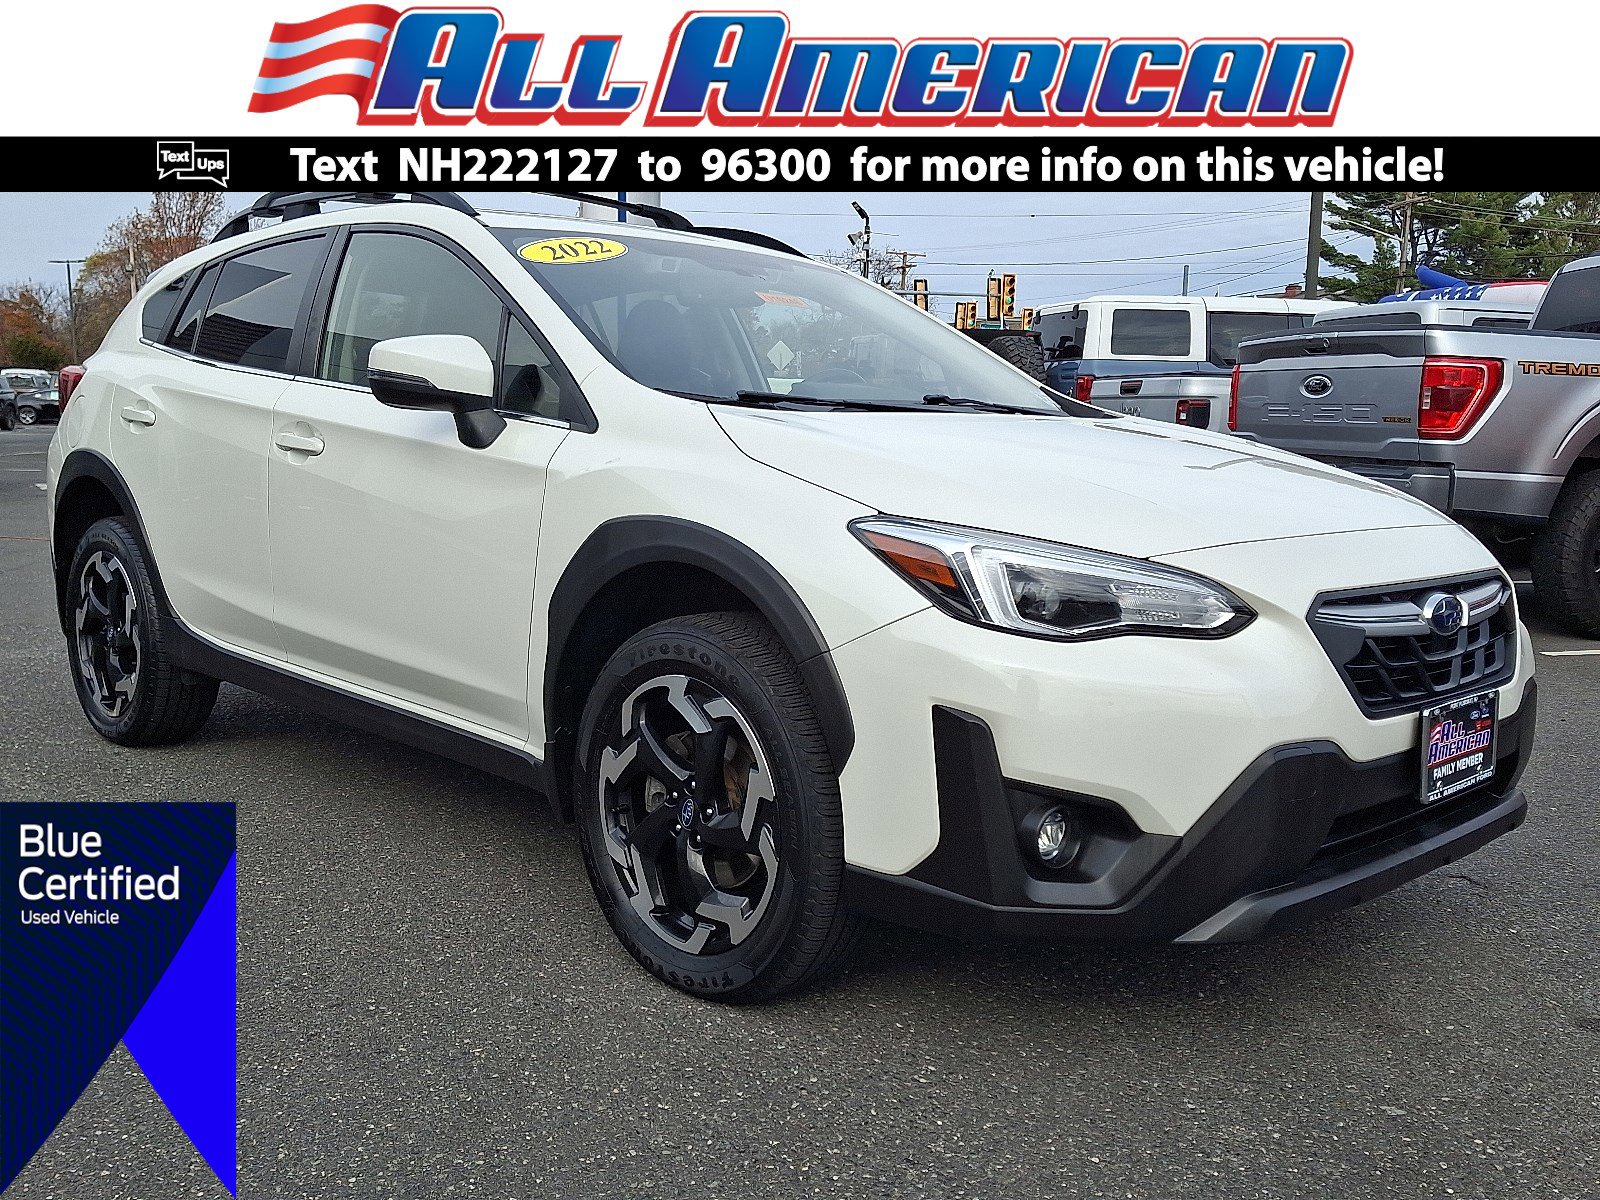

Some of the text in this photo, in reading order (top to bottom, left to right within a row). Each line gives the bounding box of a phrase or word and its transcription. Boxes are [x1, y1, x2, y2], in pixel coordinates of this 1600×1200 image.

[541, 240, 612, 260] 2022
[629, 642, 741, 689] Firestone
[1440, 720, 1466, 743] ALL
[1428, 729, 1491, 766] AMERICAN
[1433, 753, 1484, 781] FAMILY MEMBER
